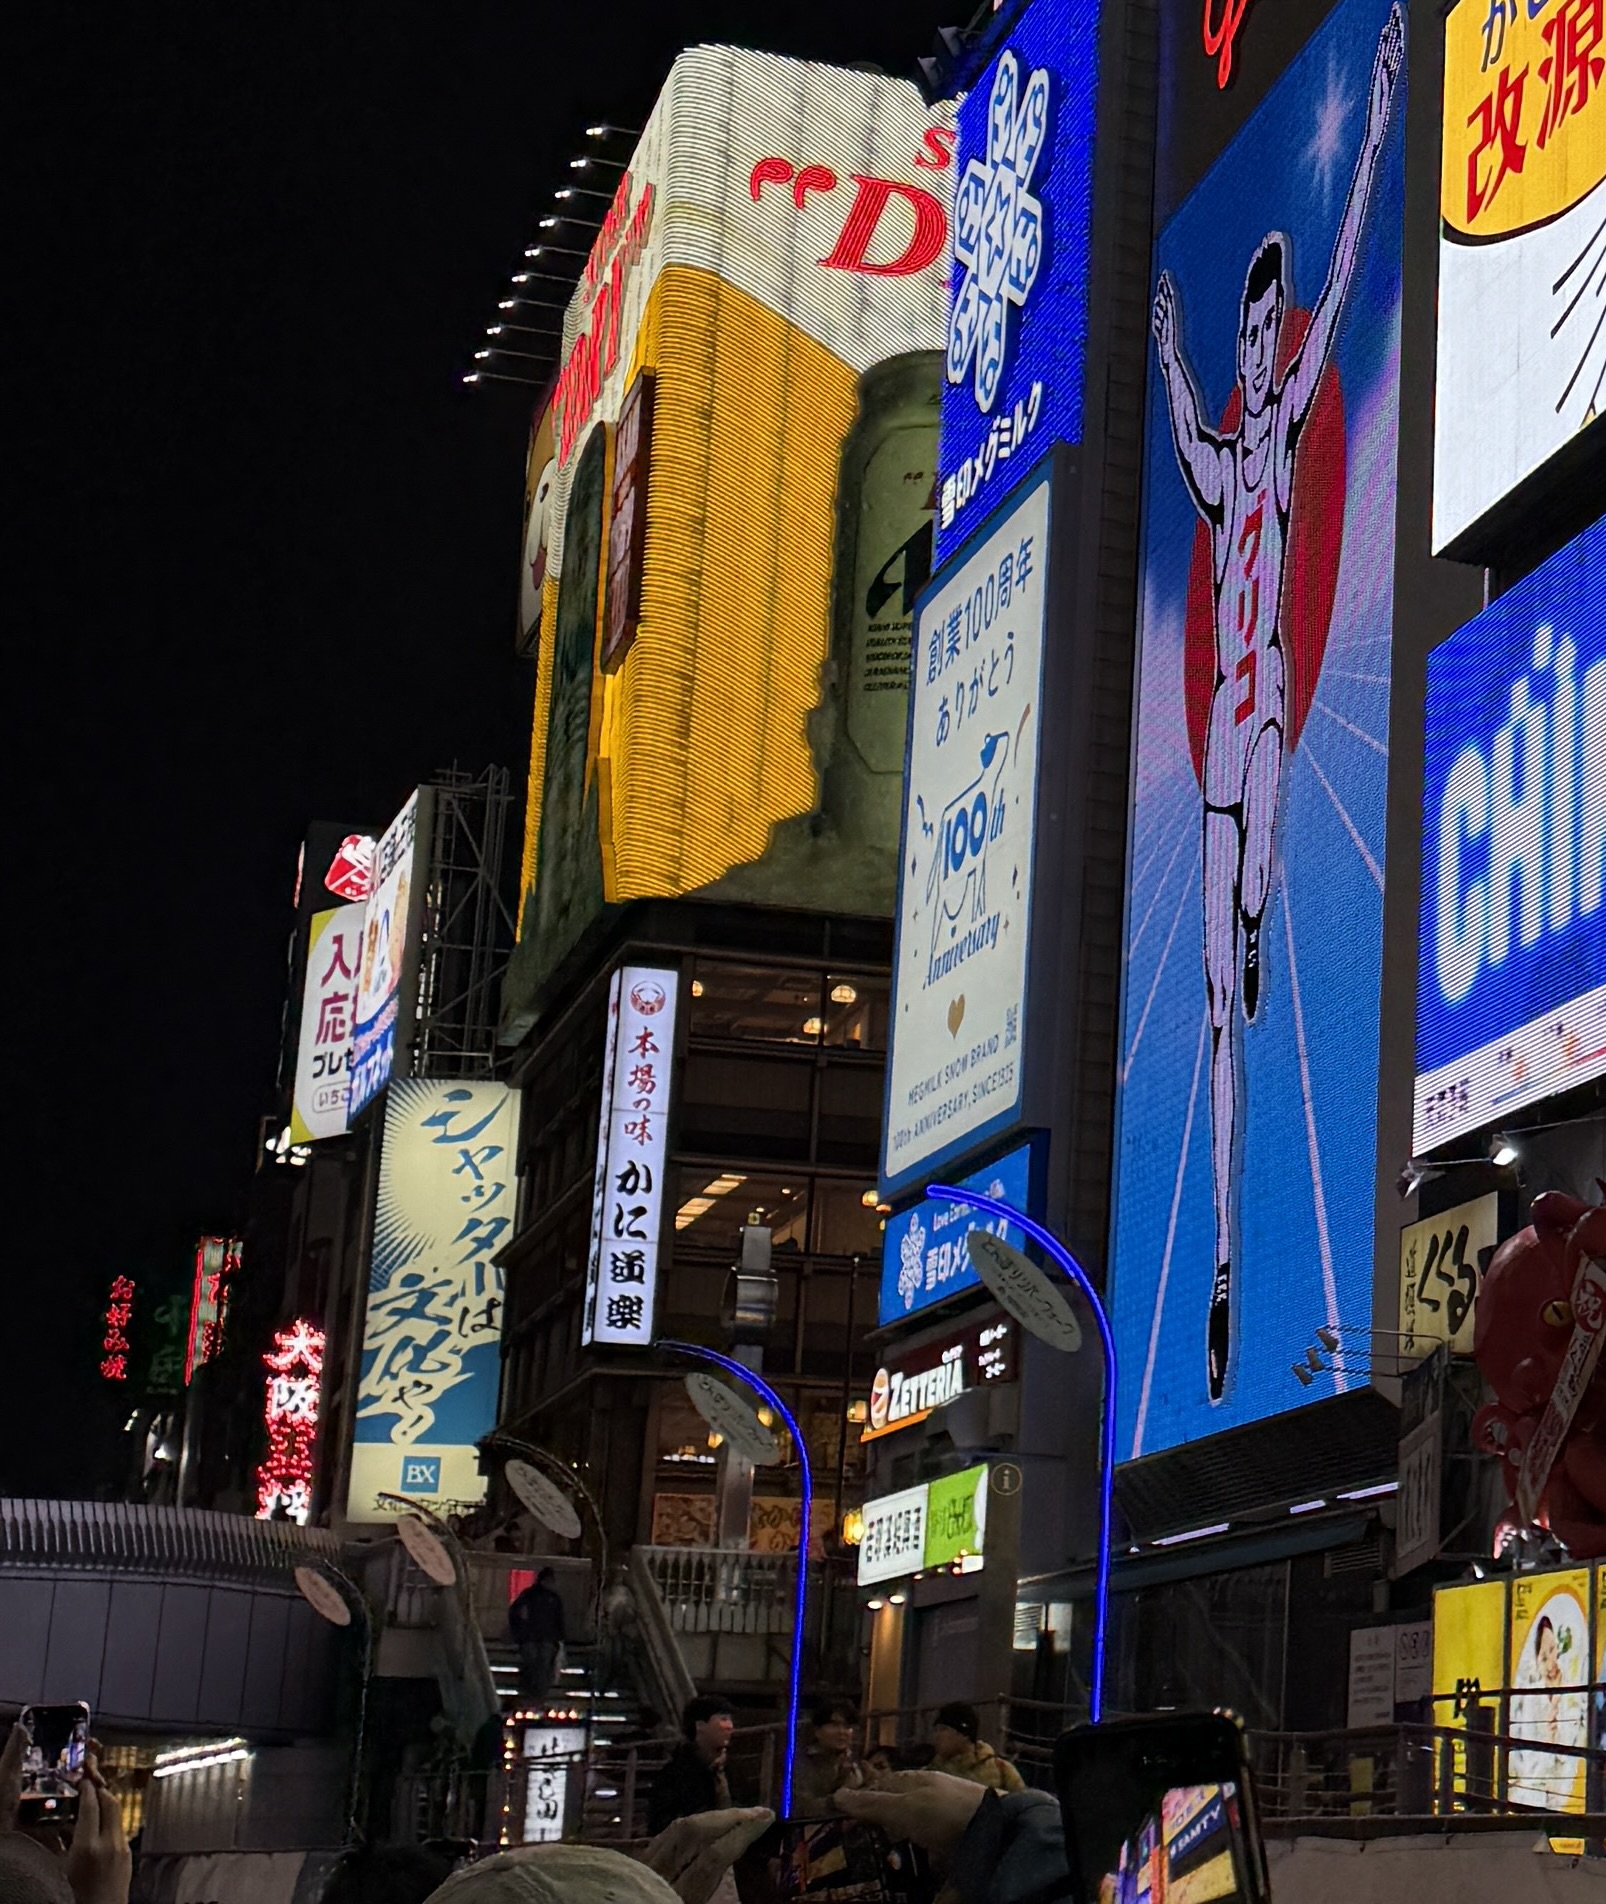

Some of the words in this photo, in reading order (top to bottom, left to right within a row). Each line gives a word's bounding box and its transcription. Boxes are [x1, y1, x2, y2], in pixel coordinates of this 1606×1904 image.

[941, 381, 1043, 530] 雪印メグミルク
[926, 536, 1034, 687] 創業100周年
[935, 631, 1016, 748] ありがとう
[943, 785, 1006, 884] 100th
[923, 911, 1002, 991] Anniversary
[623, 1026, 660, 1146] 本場の味
[971, 1034, 999, 1068] BRAND
[888, 1359, 964, 1422] ZETTERIA
[405, 1463, 436, 1485] BX
